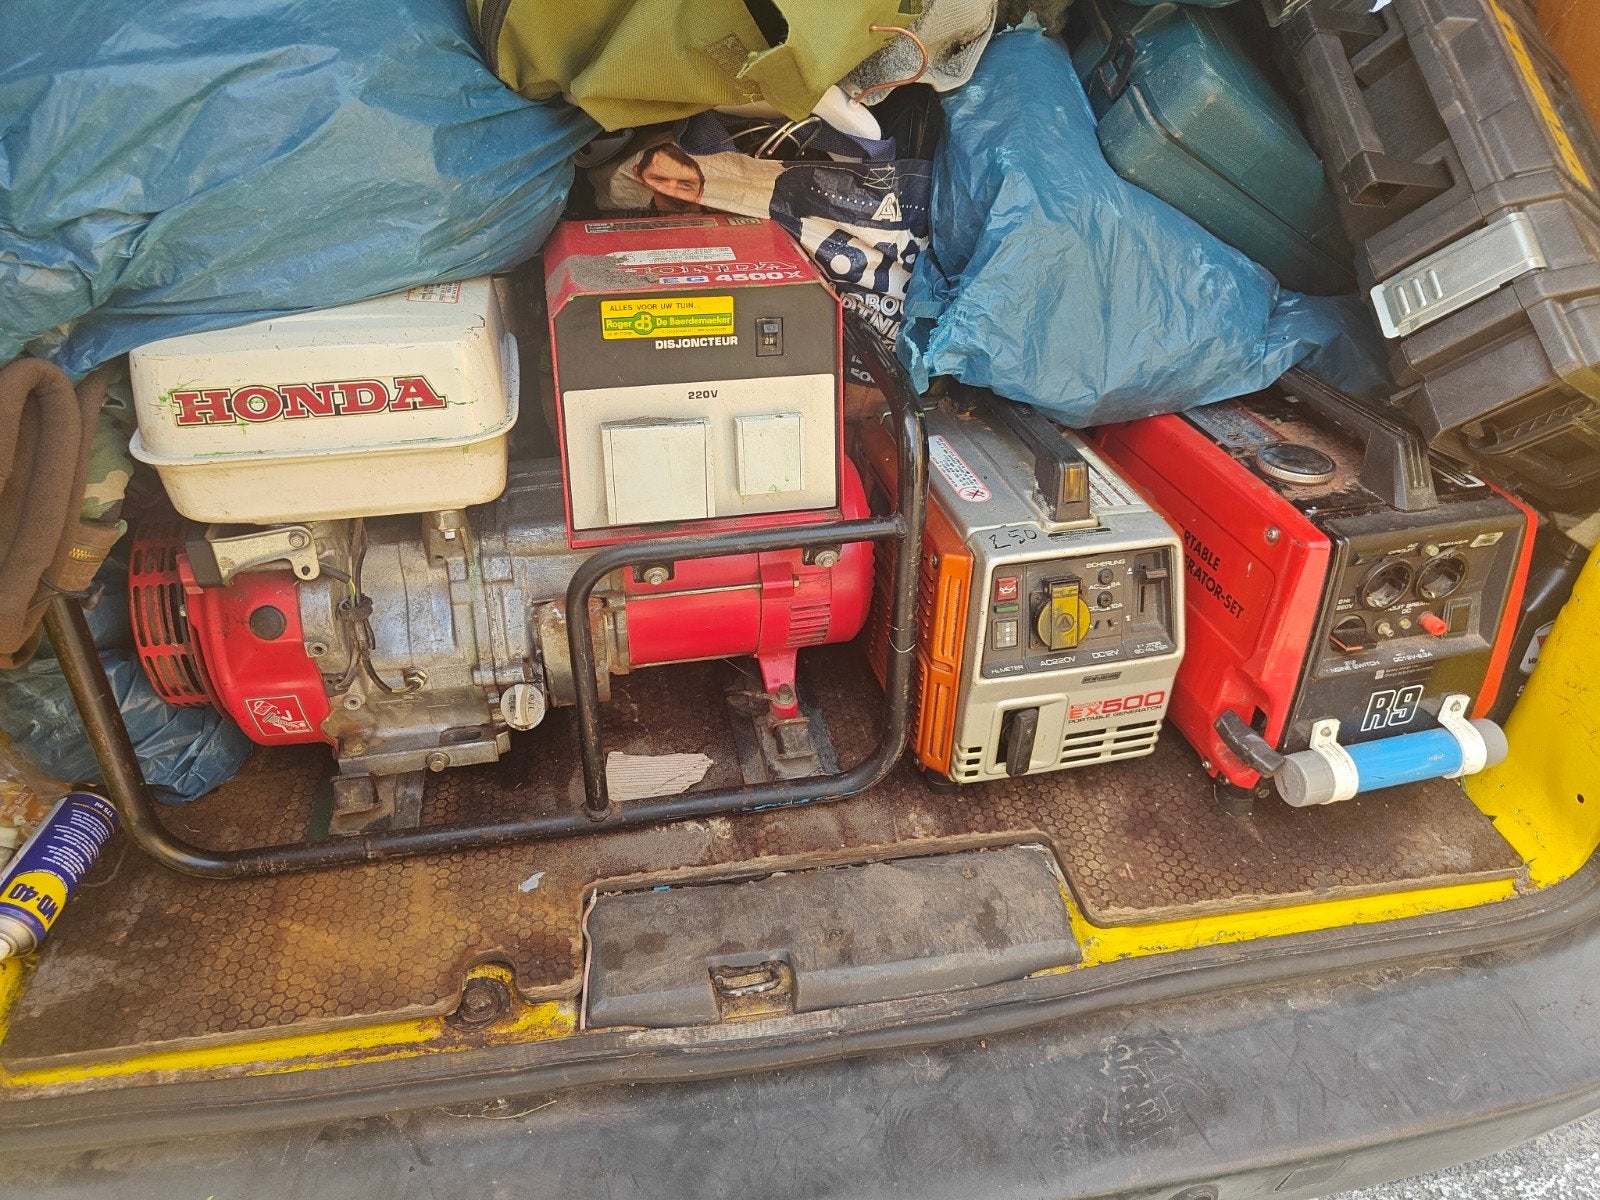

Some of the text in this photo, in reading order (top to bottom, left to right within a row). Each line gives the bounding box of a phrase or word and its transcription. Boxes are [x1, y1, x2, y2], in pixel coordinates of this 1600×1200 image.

[609, 304, 633, 312] ALLES
[637, 303, 658, 311] VOOR
[660, 302, 673, 310] UW
[606, 320, 632, 330] Roger
[656, 317, 667, 326] De
[669, 316, 731, 326] Baerdemaeker
[655, 336, 738, 350] DISJONCTEUR
[764, 337, 774, 345] ON
[172, 374, 448, 428] HONDA
[688, 389, 718, 400] 220V
[1179, 522, 1222, 572] RTABLE
[1040, 656, 1076, 667] AC220V
[1091, 649, 1119, 659] DC12V
[1069, 690, 1165, 719] EX500
[1361, 684, 1424, 732] R9
[1068, 704, 1163, 724] PORTABLE GENERATOR
[94, 800, 114, 818] 175 ml
[8, 883, 59, 924] WD-40
